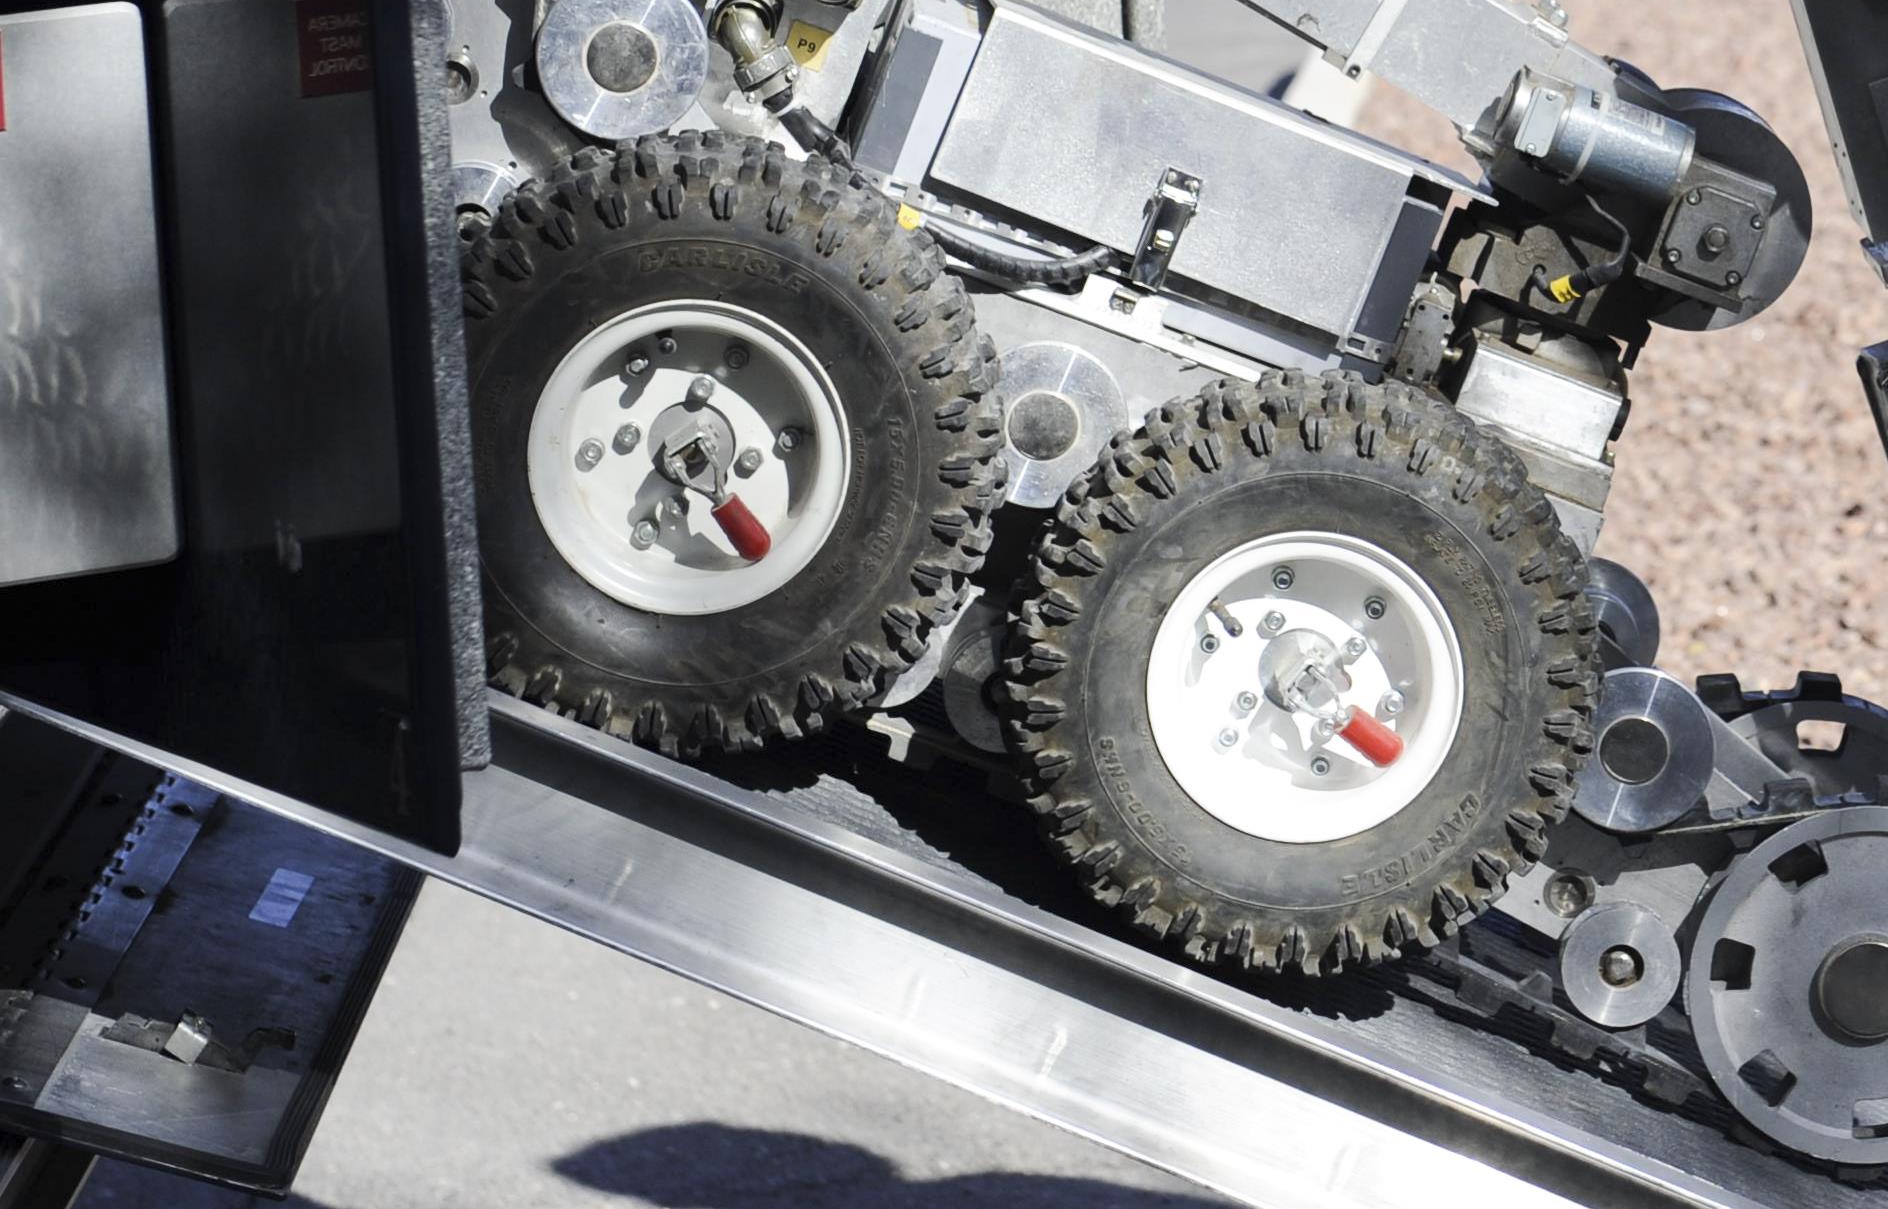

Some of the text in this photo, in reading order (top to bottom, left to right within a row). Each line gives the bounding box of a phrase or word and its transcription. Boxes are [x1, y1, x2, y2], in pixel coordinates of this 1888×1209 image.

[797, 38, 816, 53] P9
[639, 247, 810, 293] CARLISLE
[1340, 791, 1481, 897] CARLISLE
